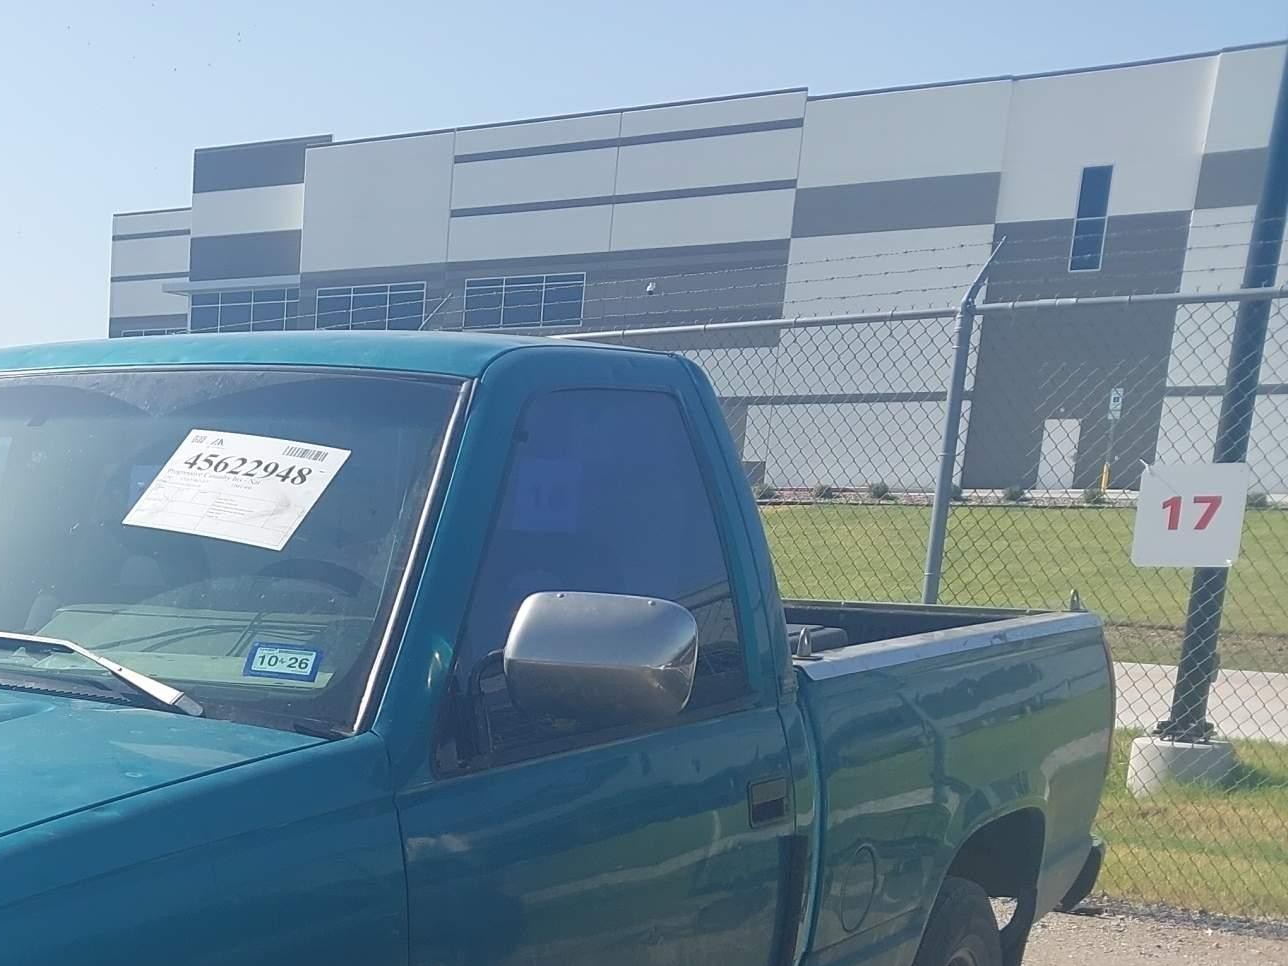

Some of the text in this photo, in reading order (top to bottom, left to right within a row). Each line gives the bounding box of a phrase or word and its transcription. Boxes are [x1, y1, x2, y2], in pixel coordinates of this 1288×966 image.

[184, 451, 313, 486] 45622948
[1161, 495, 1223, 531] 17
[258, 655, 310, 670] 10 26
